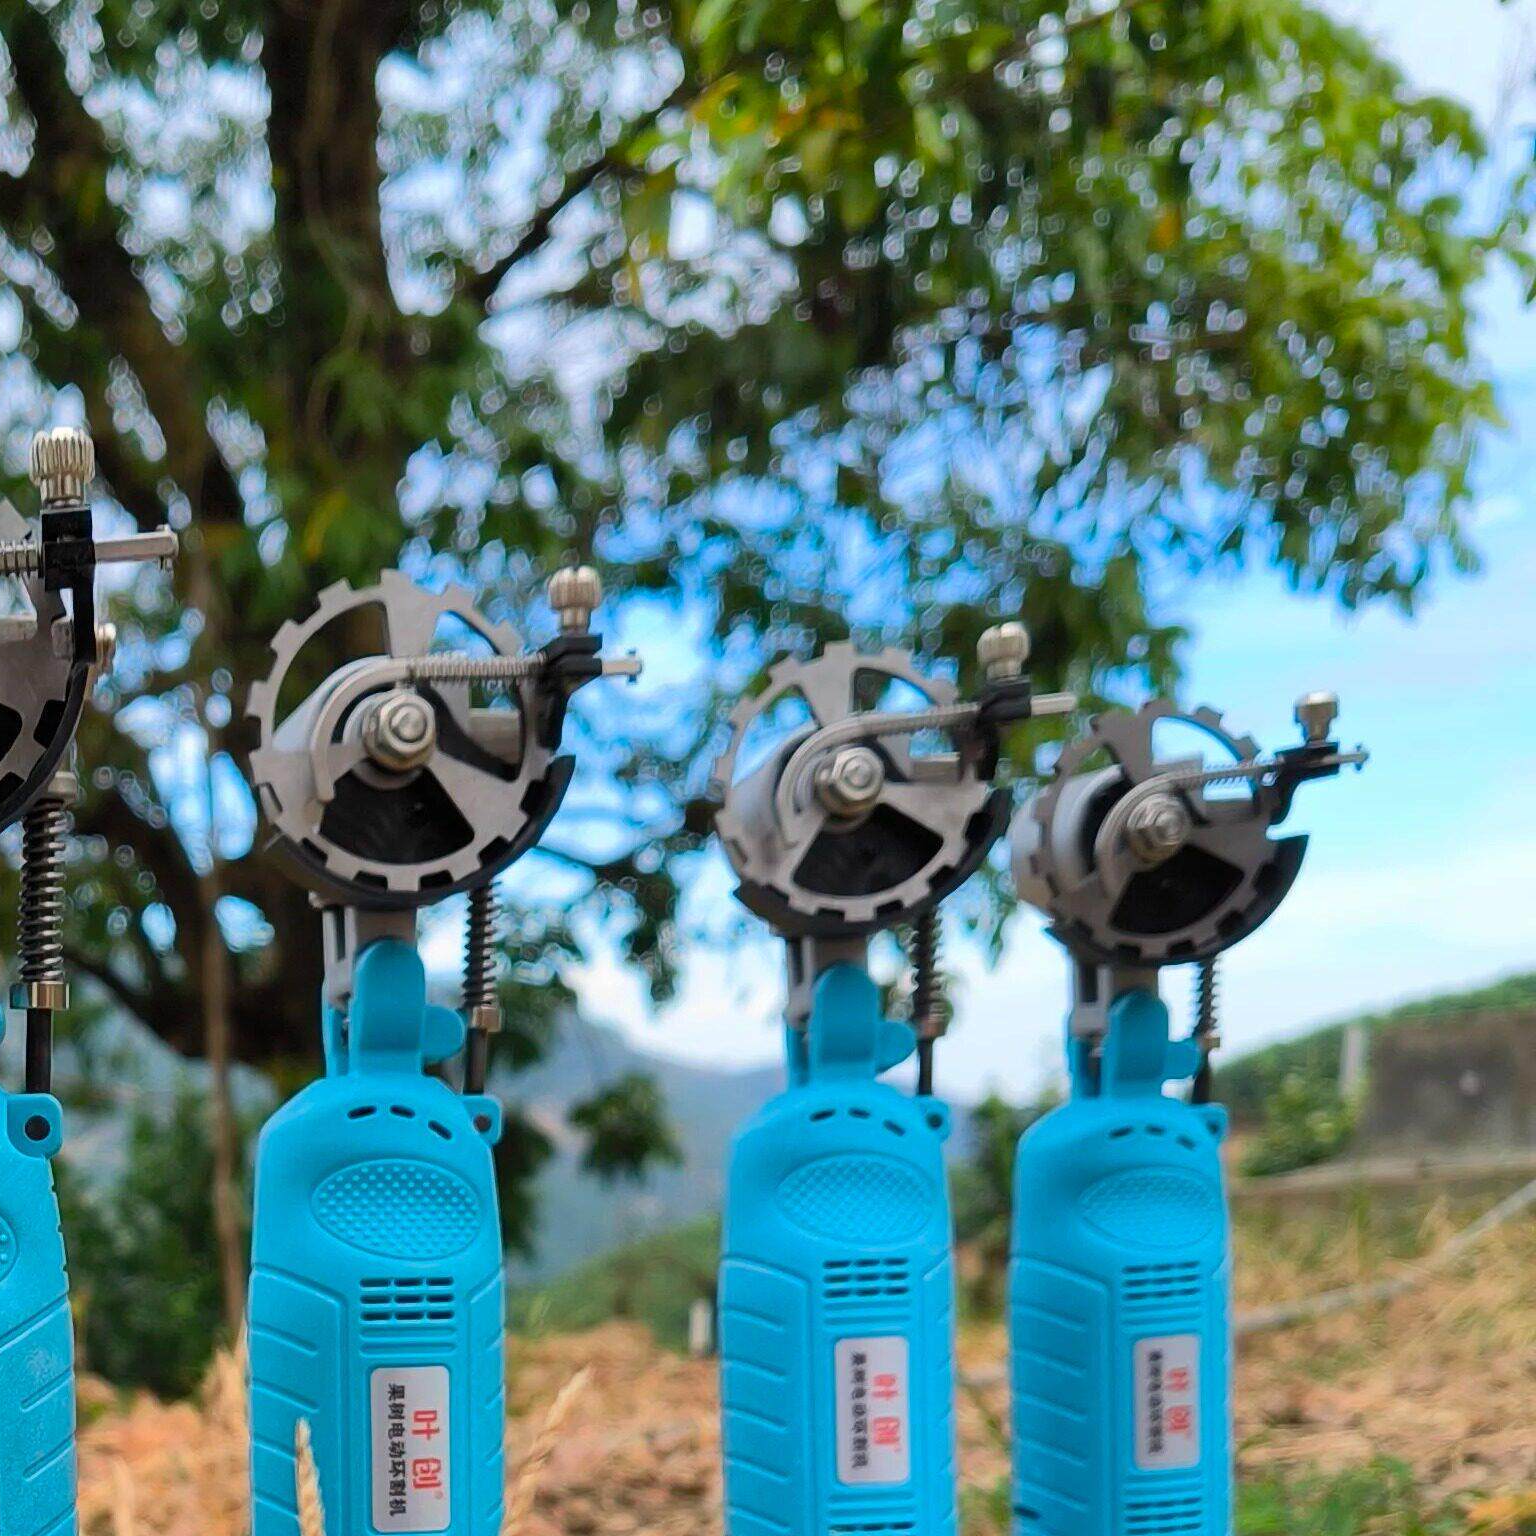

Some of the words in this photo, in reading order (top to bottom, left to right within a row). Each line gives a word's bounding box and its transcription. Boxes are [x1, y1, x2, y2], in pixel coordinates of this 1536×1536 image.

[388, 1383, 406, 1516] 果树电动环割机
